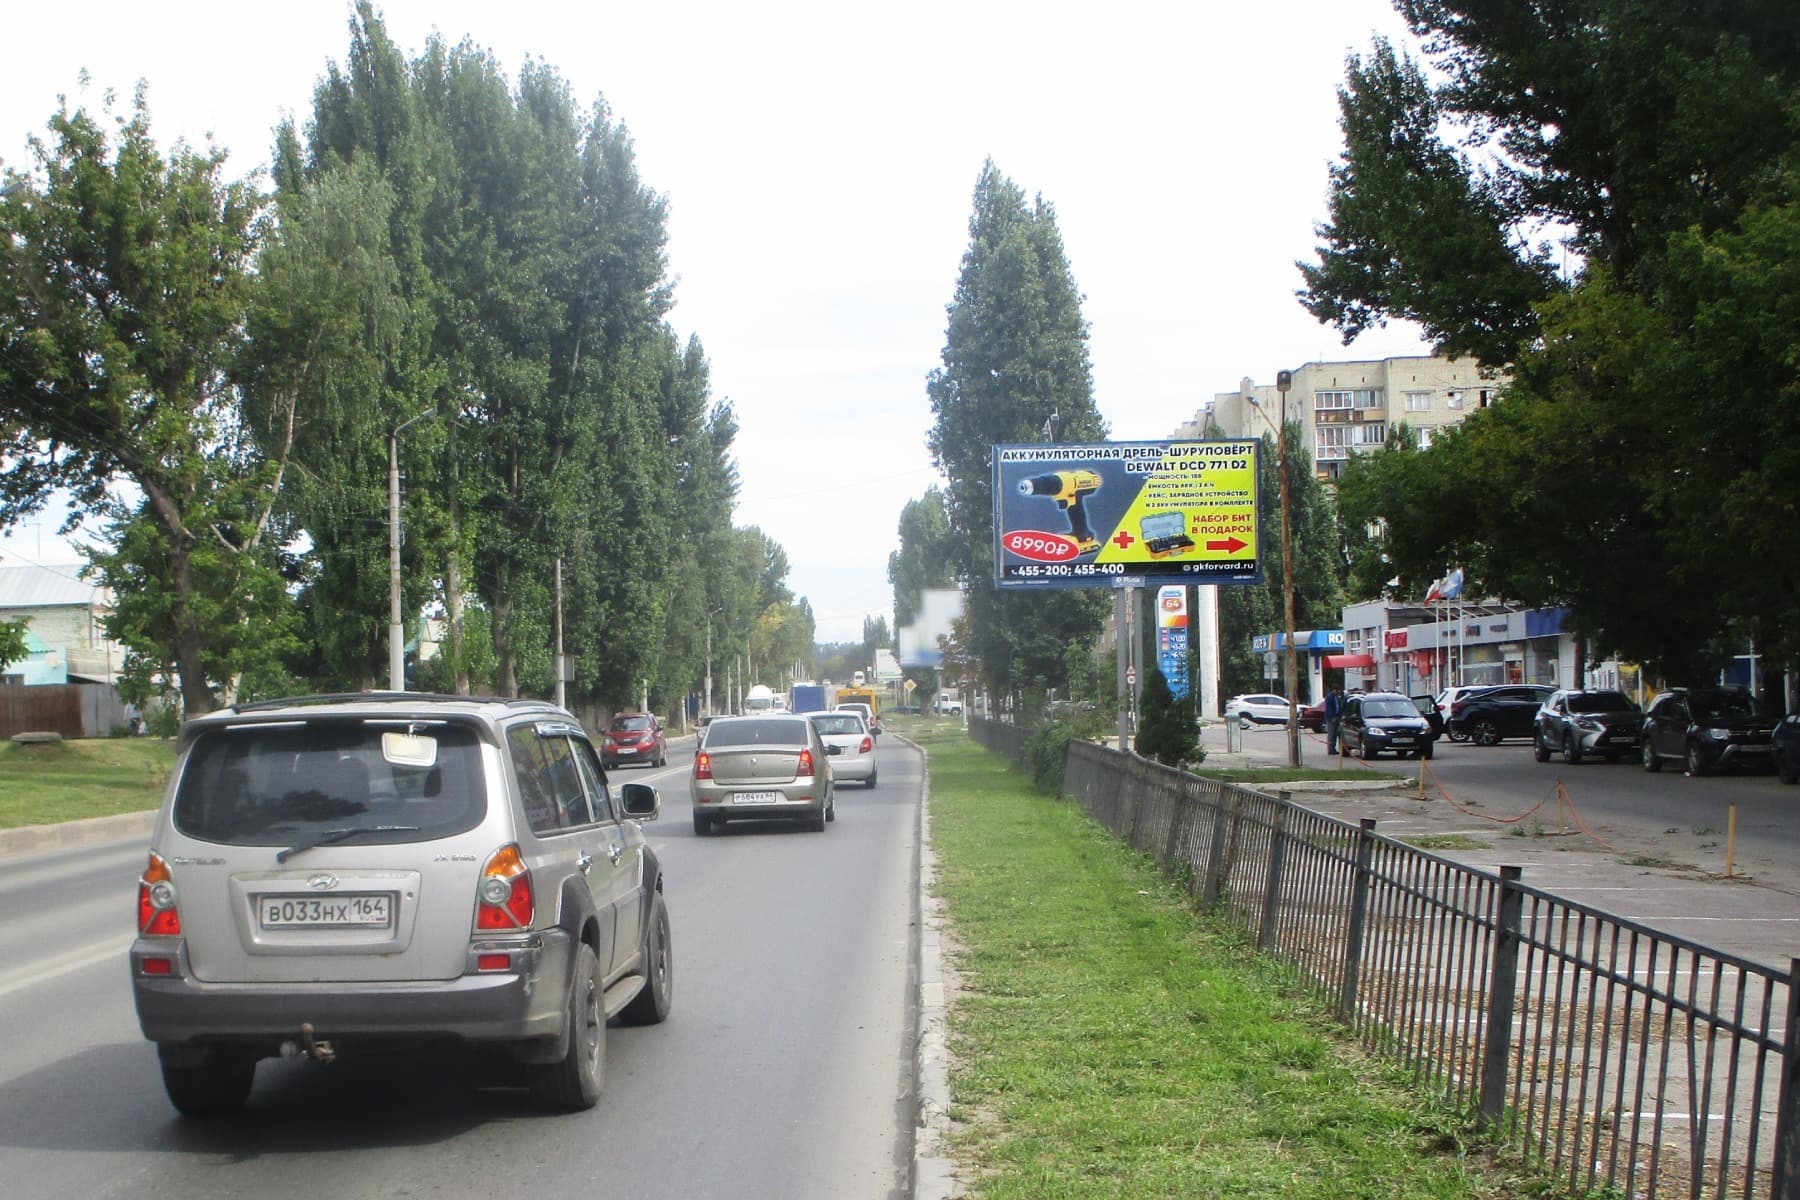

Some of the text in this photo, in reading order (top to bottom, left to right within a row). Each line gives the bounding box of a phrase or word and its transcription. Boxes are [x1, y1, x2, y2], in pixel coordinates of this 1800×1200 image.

[1002, 445, 1253, 461] АККУМУЛЯТОРНАЯ ДРЕЛЬ-ШУРУПОВЁРТ
[1127, 459, 1247, 472] DEWALT DCD 771 D2
[1193, 513, 1252, 523] НАБОР БИТ
[1192, 525, 1253, 535] В ПОДАРОК
[1075, 564, 1125, 575] 455-400
[1193, 562, 1254, 572] gkforvard.ru
[352, 899, 384, 915] 164
